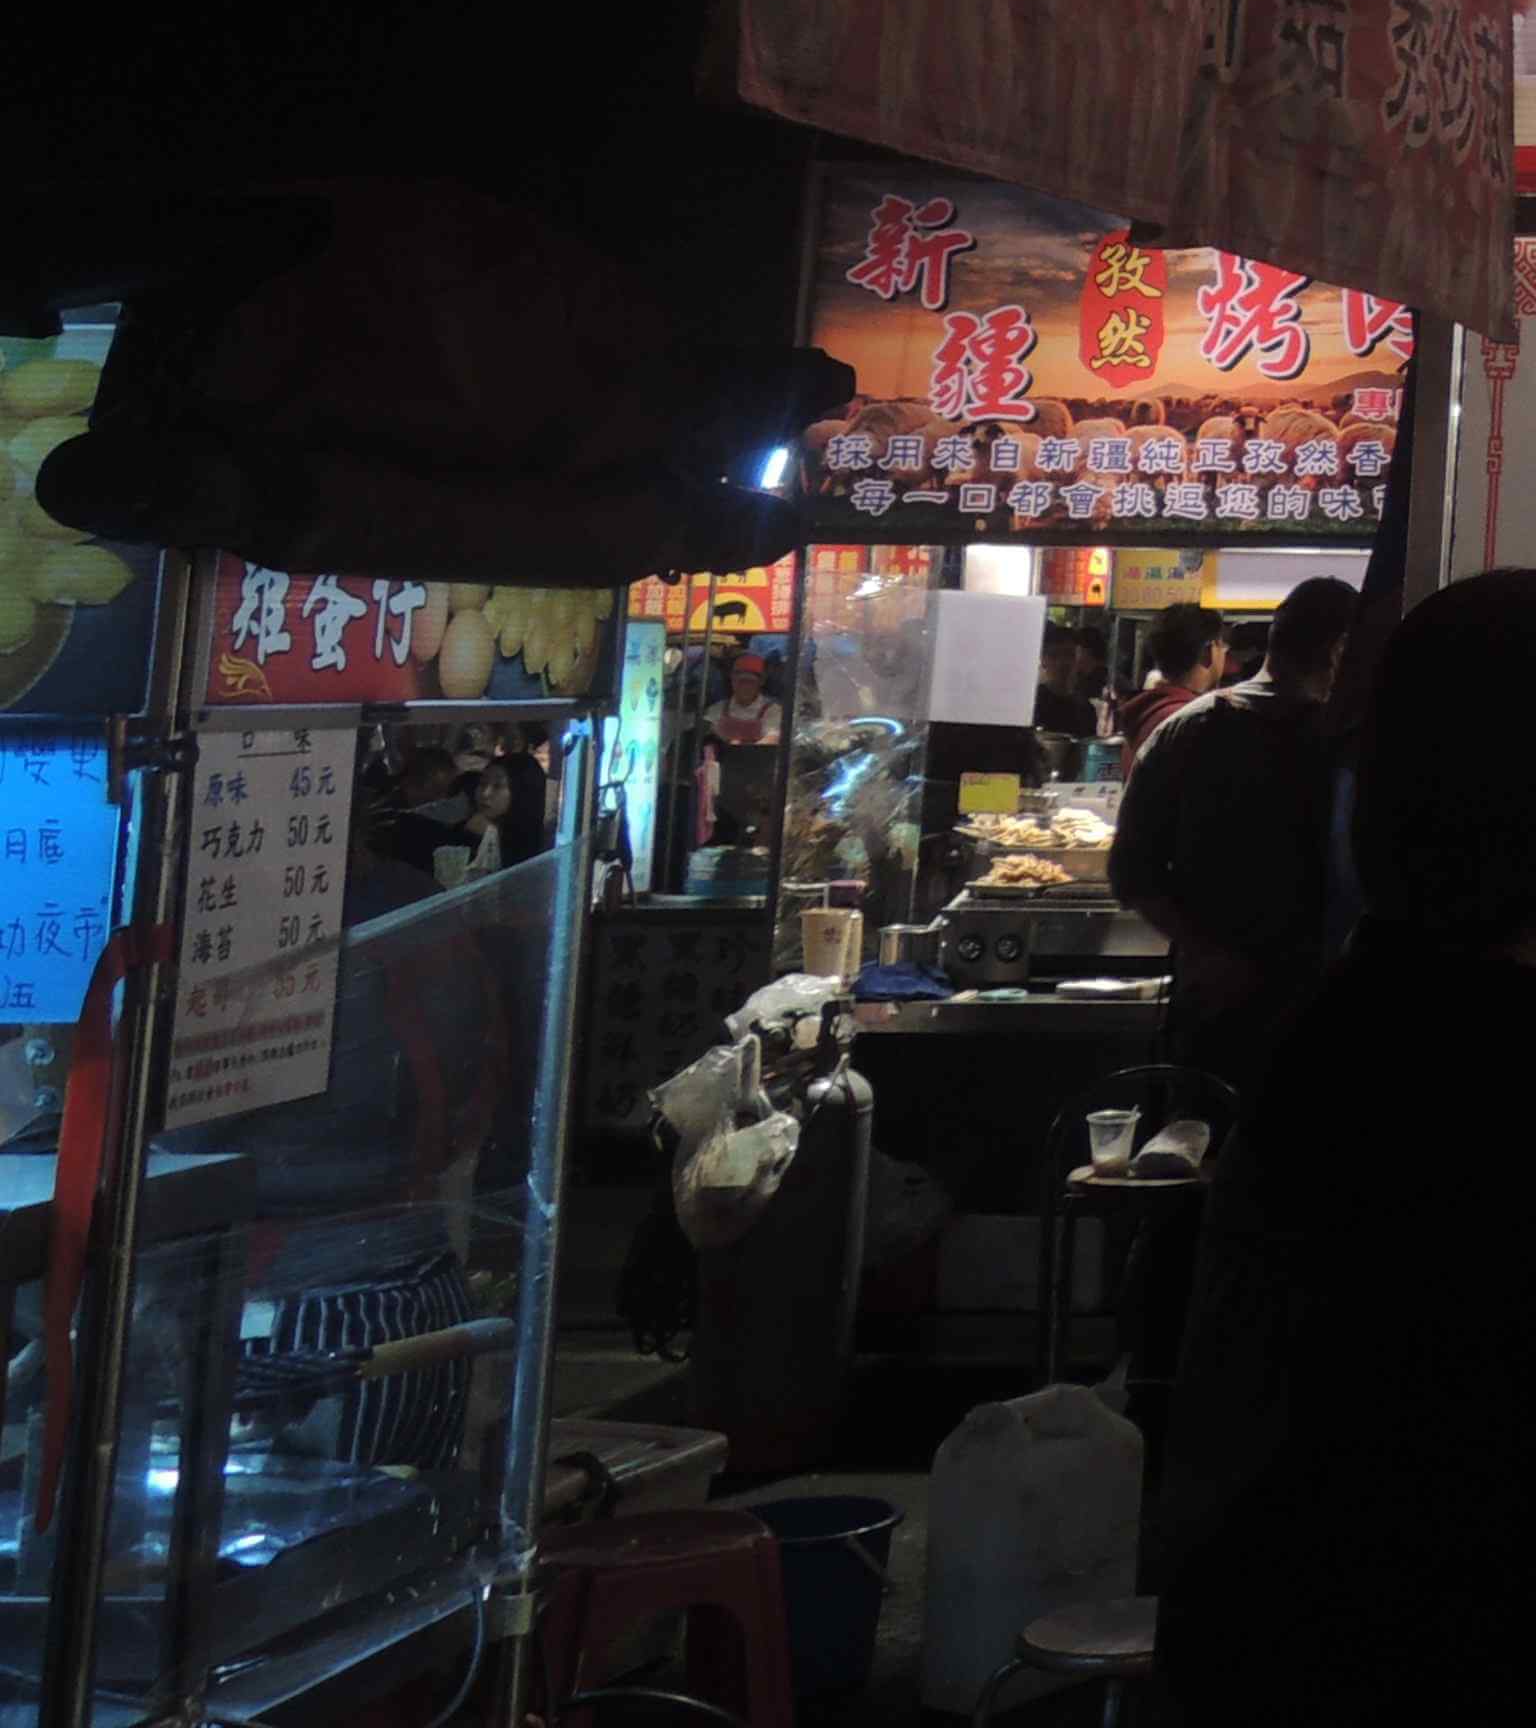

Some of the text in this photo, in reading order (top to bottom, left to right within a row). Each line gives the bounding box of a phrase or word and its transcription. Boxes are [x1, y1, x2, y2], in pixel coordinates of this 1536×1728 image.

[845, 194, 1036, 424] 新疆
[1090, 242, 1164, 371] 孜然
[850, 480, 1388, 522] 每一口都會挑逗您的味
[201, 814, 333, 859] 巧克力 50元
[284, 864, 329, 898] 50元
[279, 913, 324, 948] 50元
